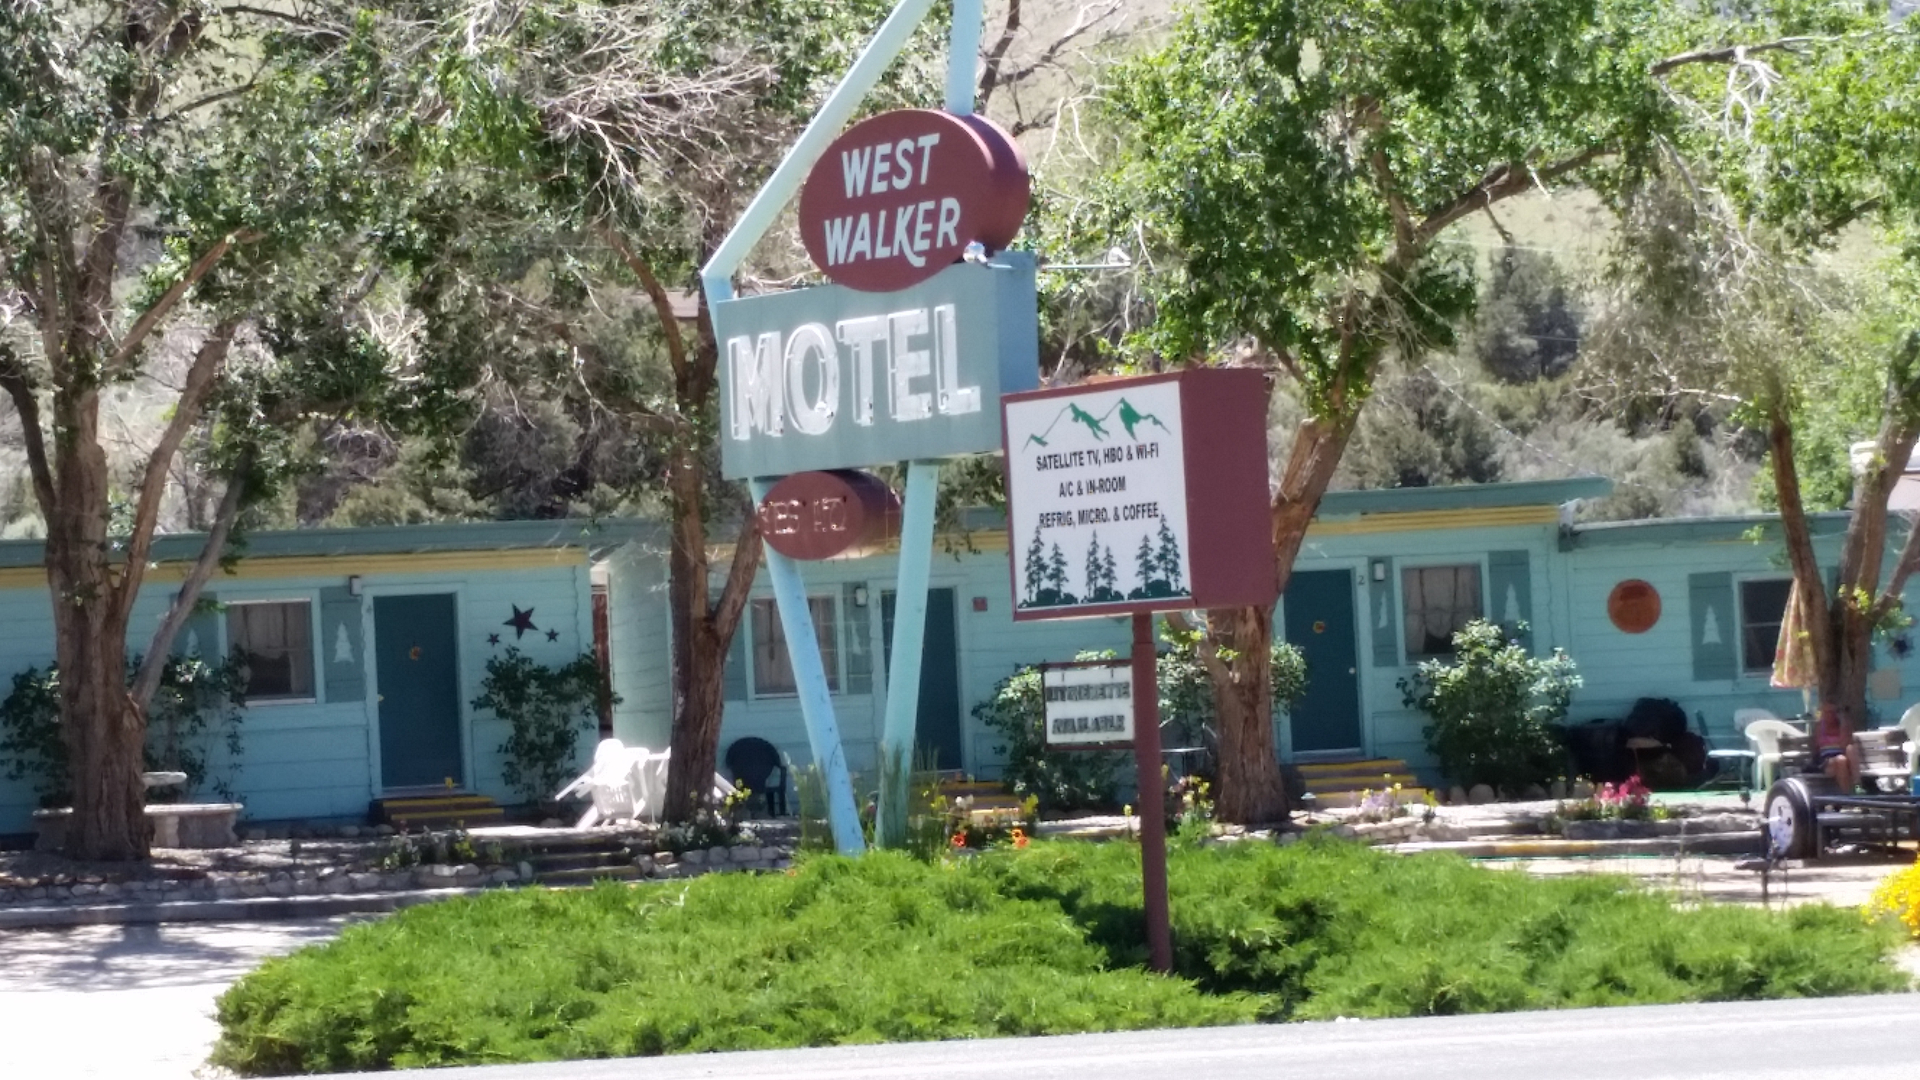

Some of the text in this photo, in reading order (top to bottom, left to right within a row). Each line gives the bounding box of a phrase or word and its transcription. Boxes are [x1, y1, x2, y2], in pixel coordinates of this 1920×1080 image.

[842, 133, 940, 198] WEST
[824, 198, 961, 267] WALKER
[728, 304, 981, 440] MOTEL
[1036, 442, 1159, 471] SATELLITE TV, HBO & WI-FI
[1059, 476, 1126, 498] A/C & IN-ROOM
[1078, 507, 1110, 525] MICRO.
[1113, 507, 1119, 522] &
[1123, 502, 1159, 520] COFFEE
